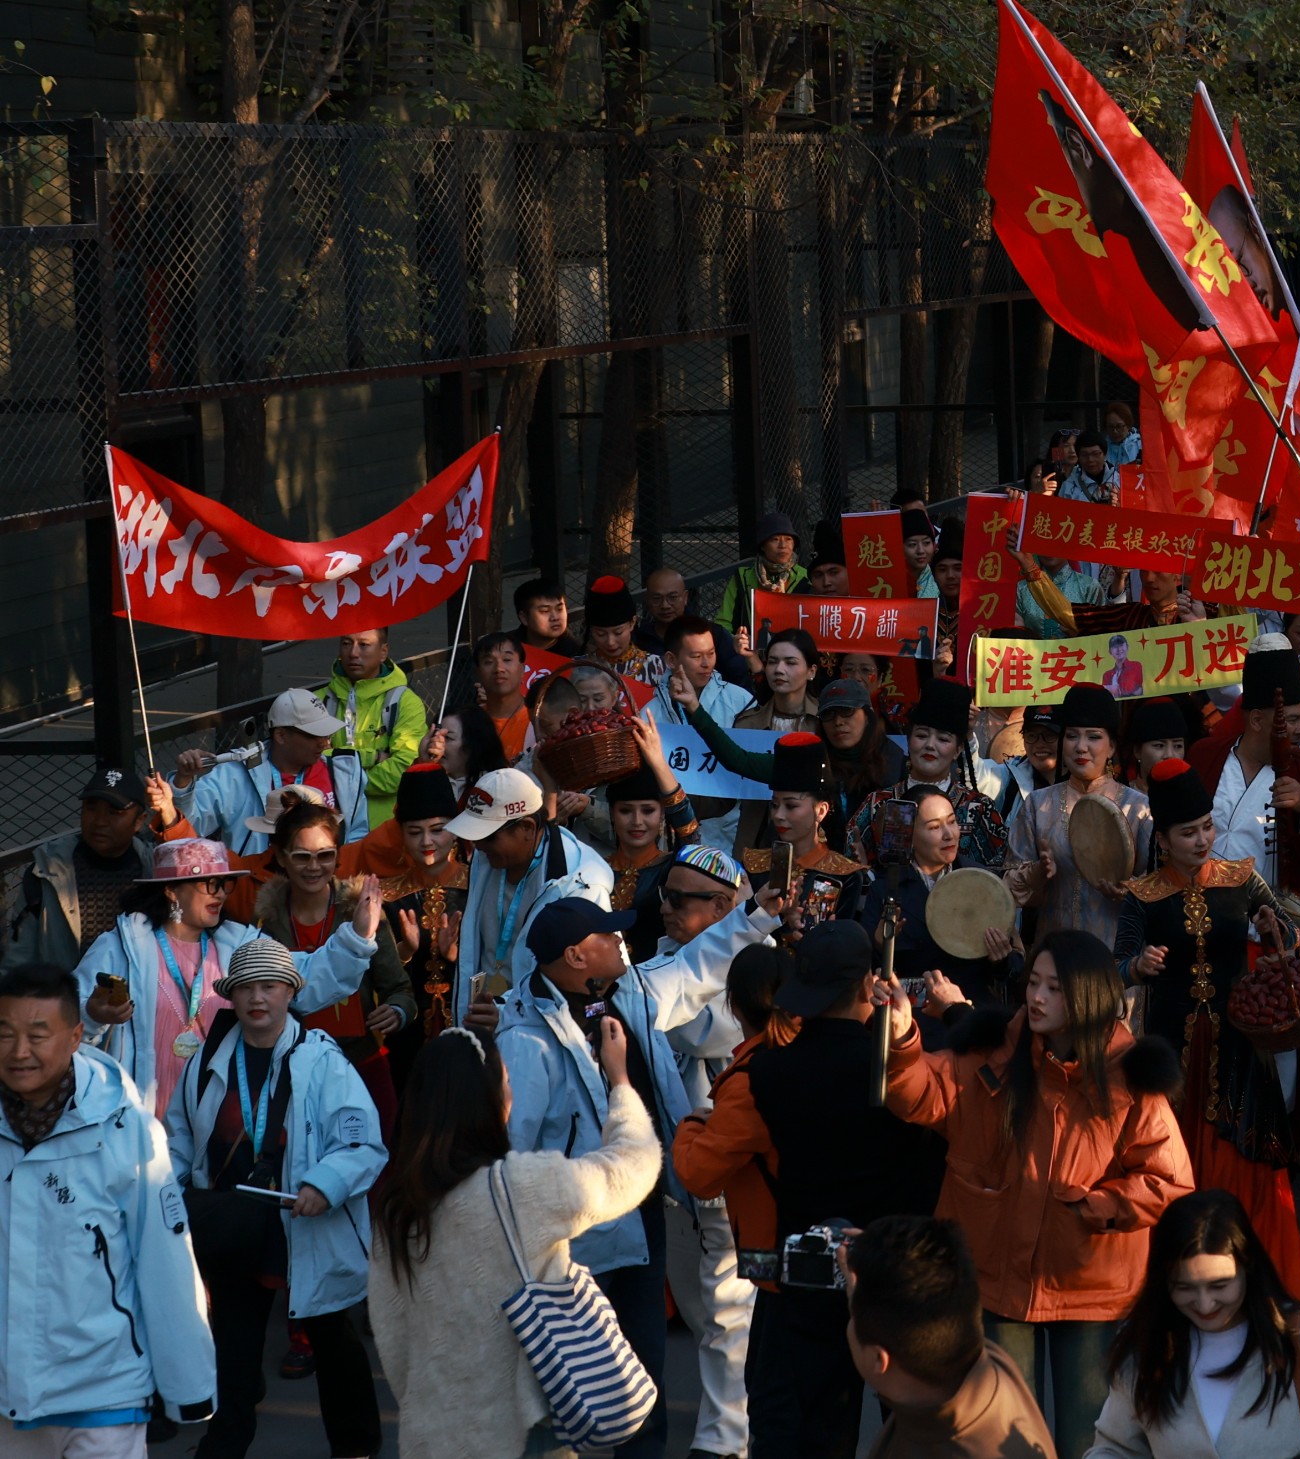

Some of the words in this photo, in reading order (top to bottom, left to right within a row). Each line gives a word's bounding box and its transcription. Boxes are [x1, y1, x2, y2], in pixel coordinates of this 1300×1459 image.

[1030, 512, 1196, 561] 魅力麦盖提欢迎
[986, 645, 1087, 695] 淮安
[1153, 629, 1247, 685] 刀迷
[504, 800, 527, 816] 1932
